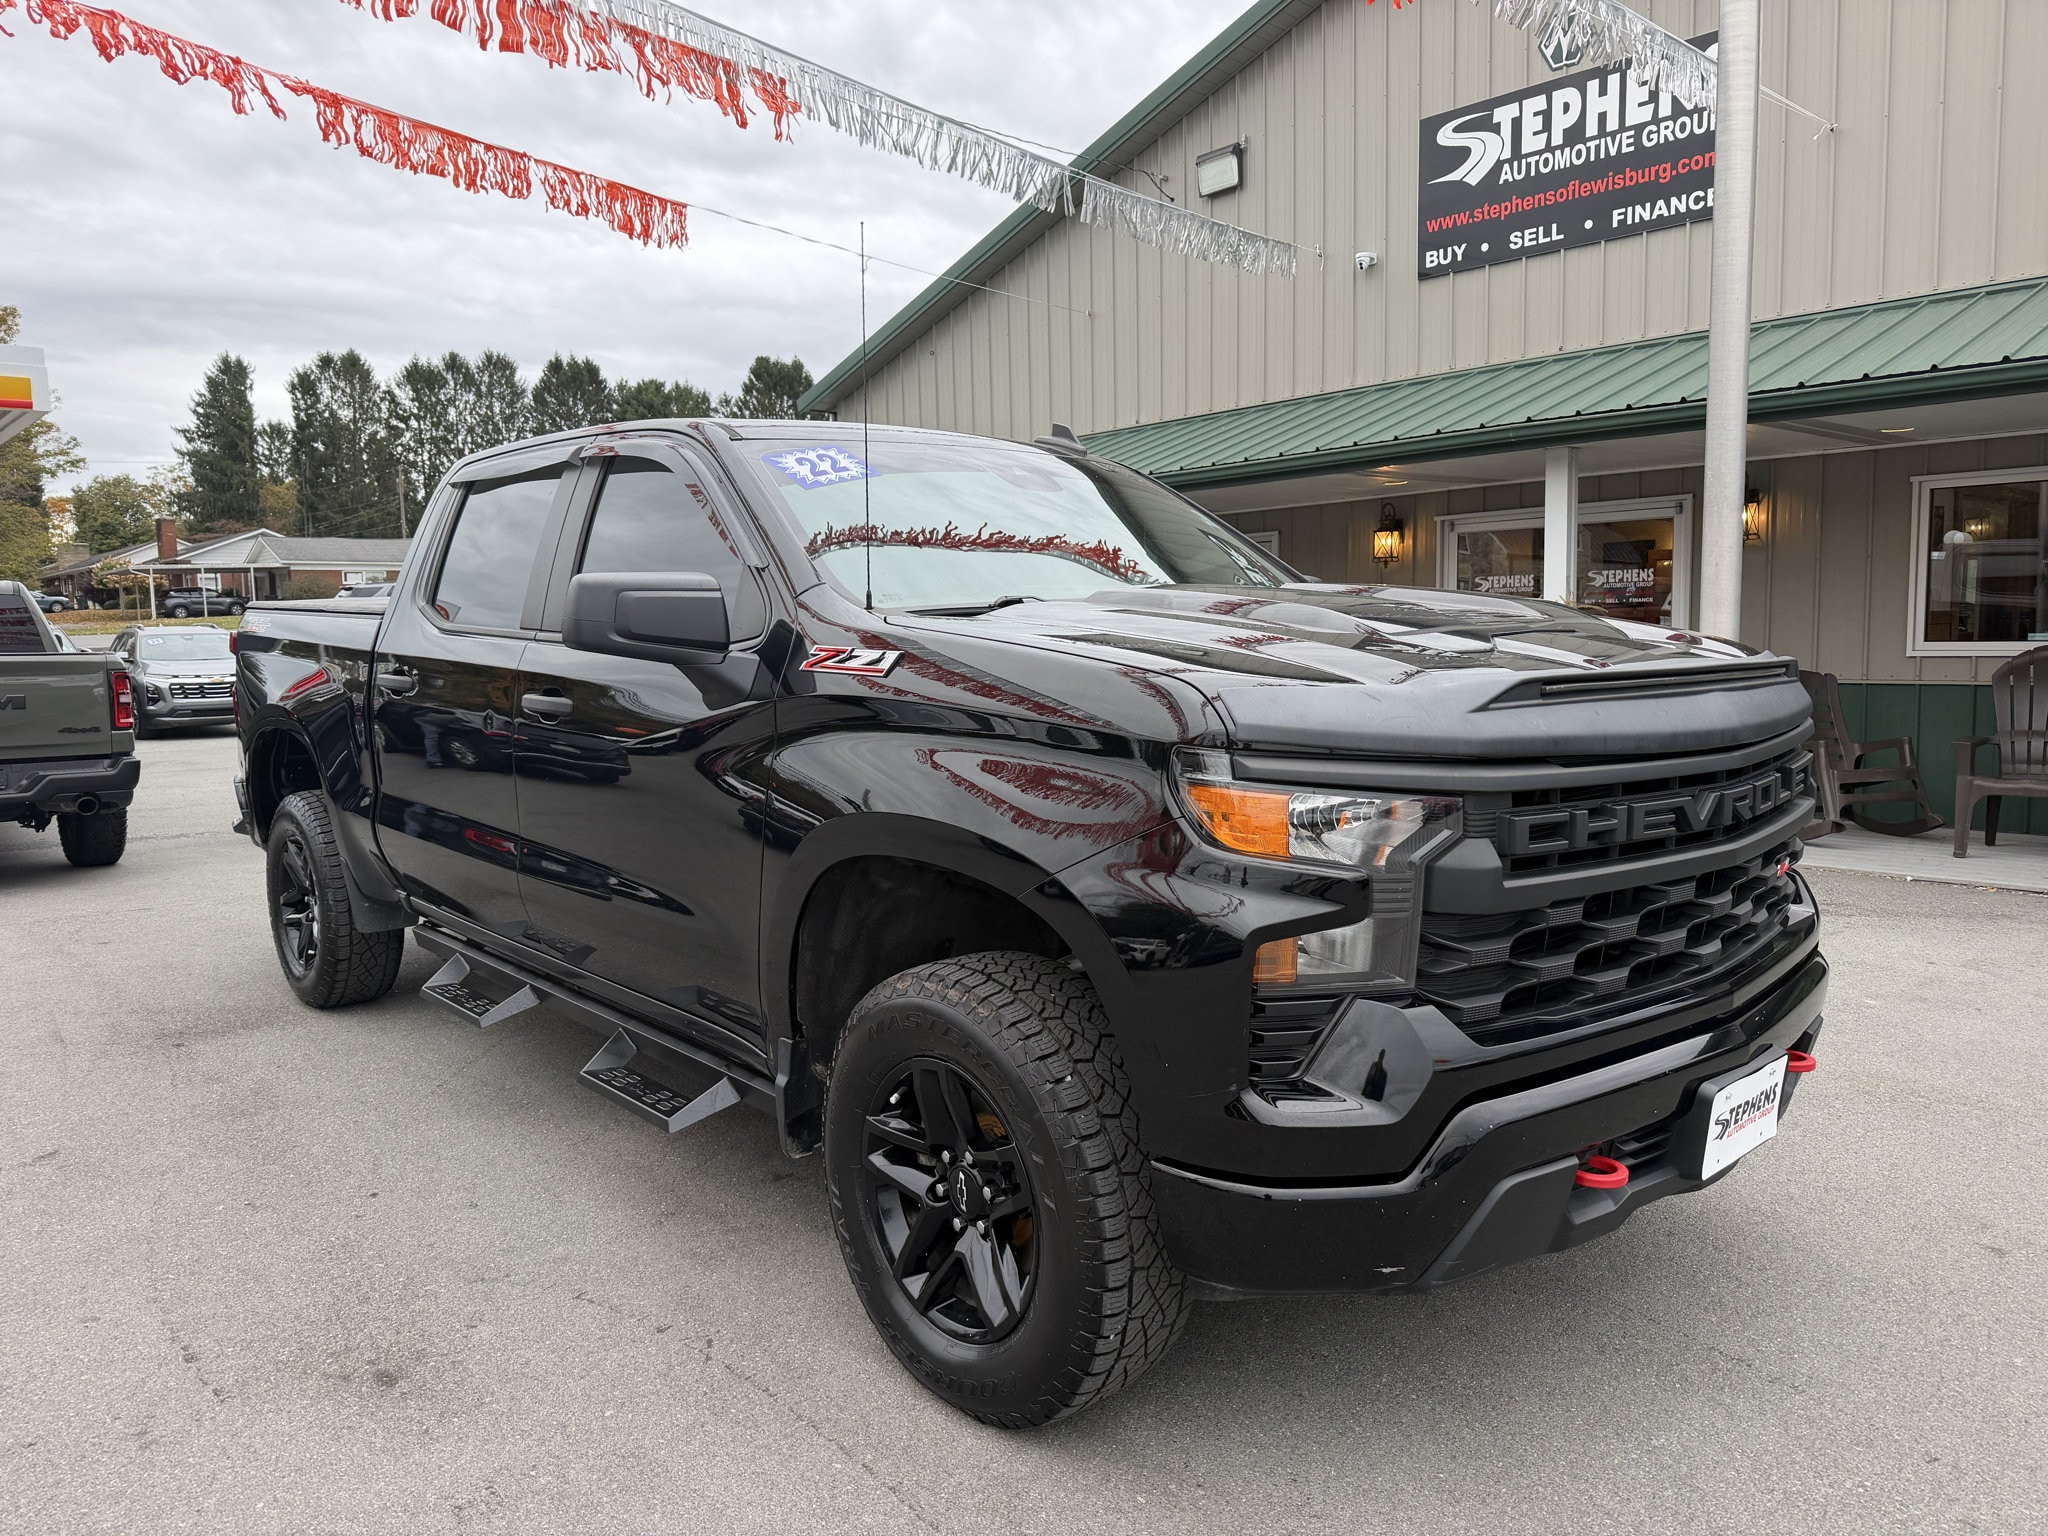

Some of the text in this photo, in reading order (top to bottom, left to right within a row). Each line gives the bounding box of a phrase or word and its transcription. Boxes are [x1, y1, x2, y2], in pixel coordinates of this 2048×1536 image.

[1427, 42, 1718, 187] STEPHE
[1499, 130, 1636, 185] AUTOMOTIVE
[1425, 243, 1468, 269] BUY
[1508, 223, 1565, 251] SELL
[794, 453, 852, 477] 22
[1473, 574, 1535, 592] STEPHENS
[1585, 568, 1655, 588] STEPHENS
[798, 644, 906, 678] Z71
[1712, 1081, 1779, 1142] STEPHENS
[1726, 1104, 1775, 1138] AUTOMOTIVE GROUP
